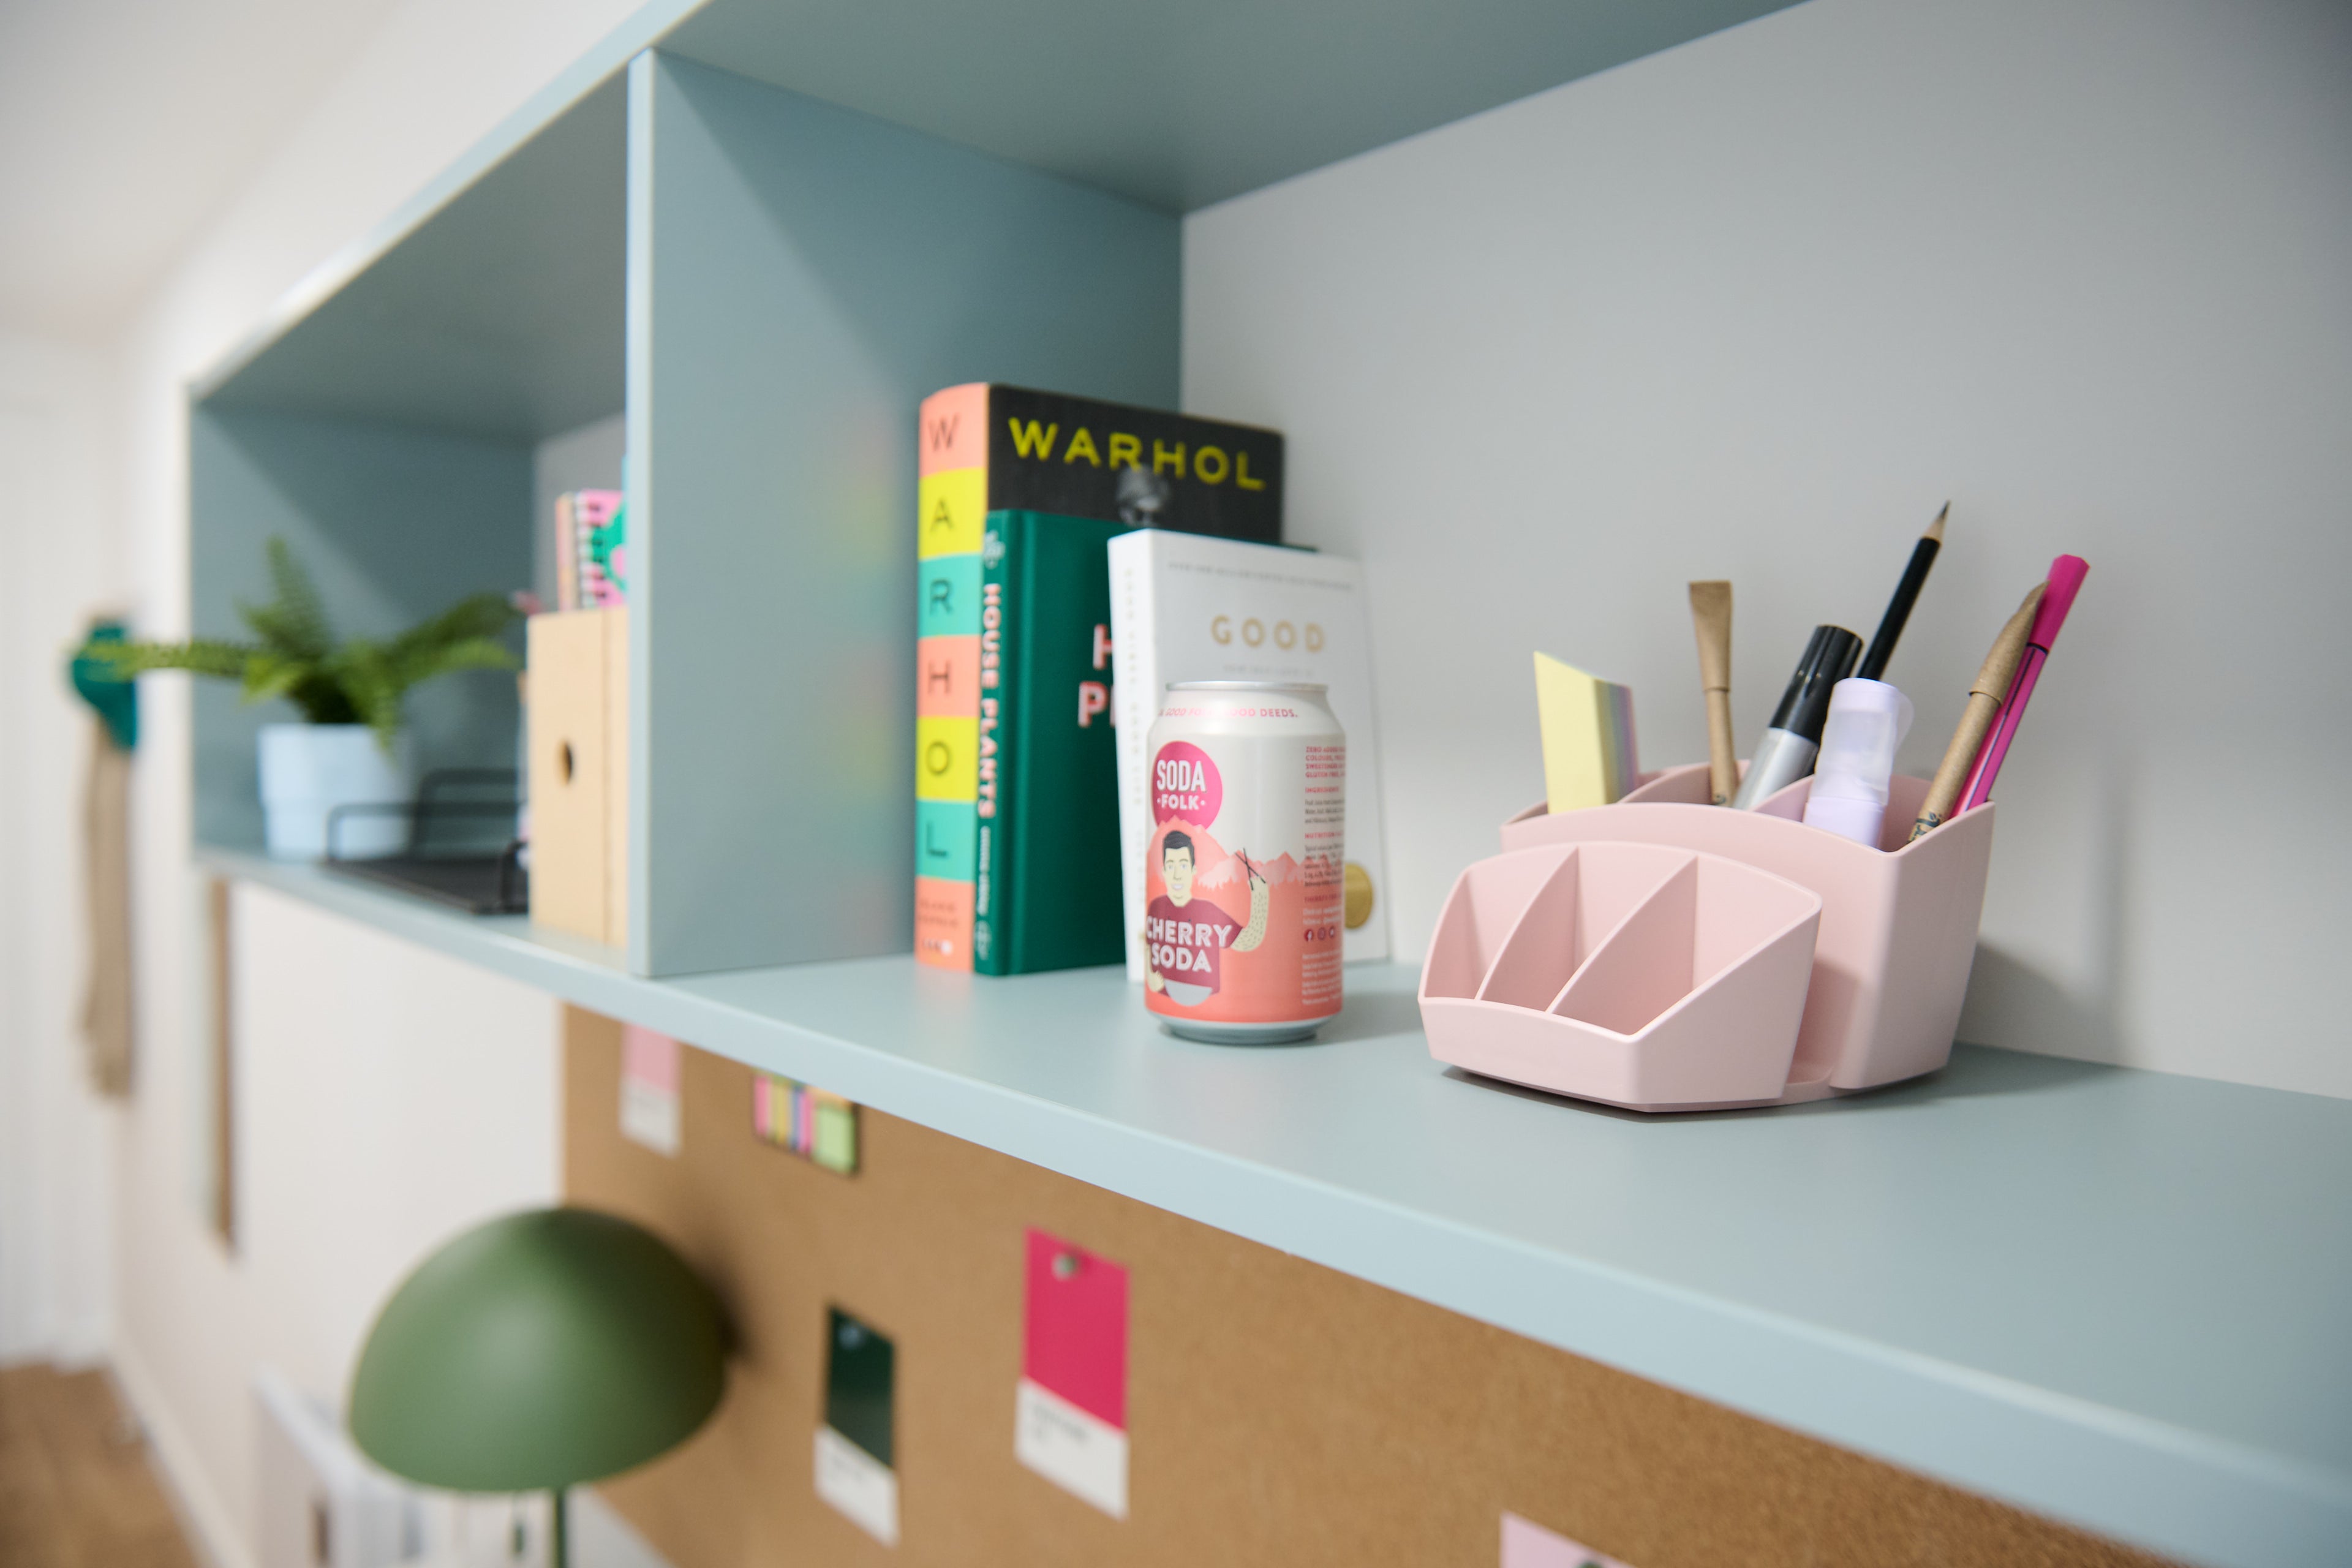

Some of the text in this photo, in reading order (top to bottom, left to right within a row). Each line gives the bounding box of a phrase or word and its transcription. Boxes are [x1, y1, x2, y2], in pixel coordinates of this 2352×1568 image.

[1008, 417, 1266, 491] WARHOL
[981, 582, 1001, 688] HOUSE
[1210, 614, 1325, 654] GOOD
[1259, 707, 1298, 718] DEEDS.
[978, 698, 999, 818] PLANTS
[1156, 759, 1206, 792] SODA
[1147, 915, 1232, 948] CHERRY
[1152, 942, 1212, 973] SODA
